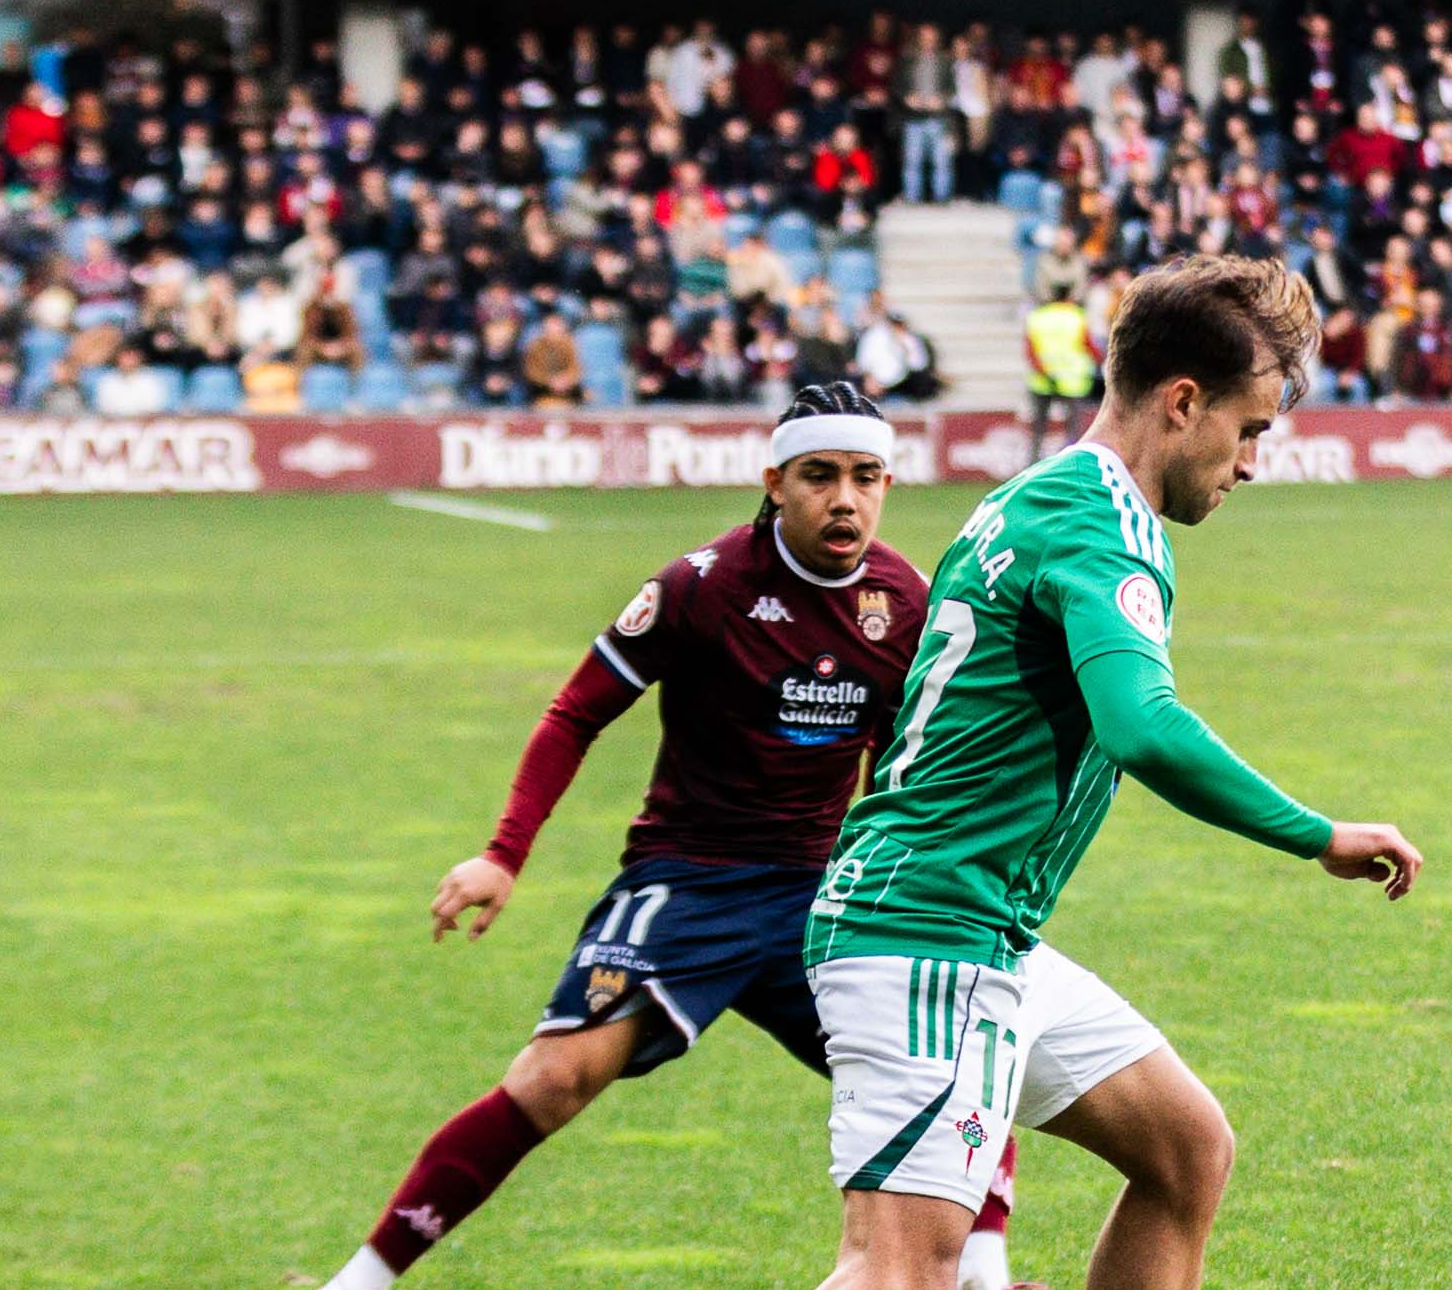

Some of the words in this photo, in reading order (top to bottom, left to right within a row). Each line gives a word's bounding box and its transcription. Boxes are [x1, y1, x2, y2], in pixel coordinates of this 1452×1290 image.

[441, 423, 600, 488] Diario
[778, 702, 858, 725] Galicia
[780, 677, 867, 704] Estrella
[889, 596, 977, 792] 7
